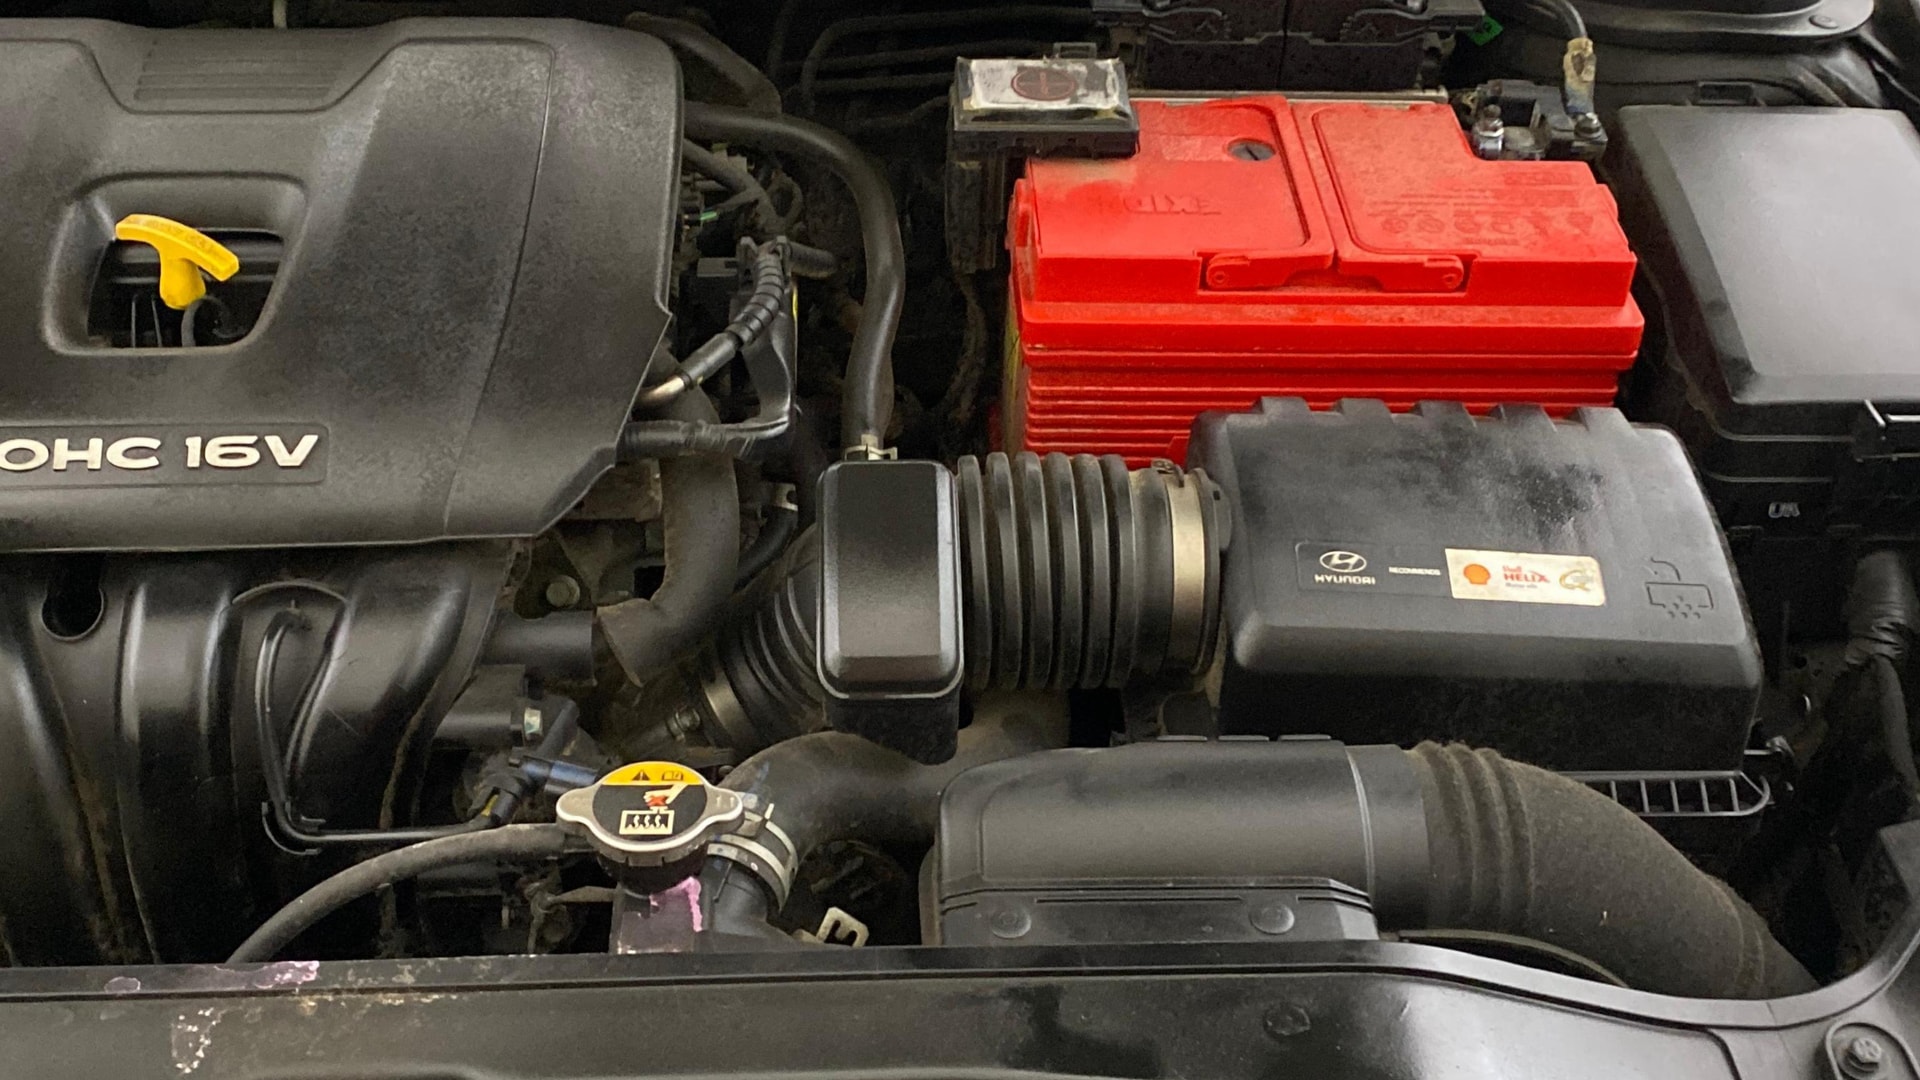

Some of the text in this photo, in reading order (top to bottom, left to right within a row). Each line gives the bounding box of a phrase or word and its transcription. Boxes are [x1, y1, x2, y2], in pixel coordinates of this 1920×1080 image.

[0, 434, 319, 471] OHC 16V
[1314, 574, 1376, 585] HYUNDAI
[1503, 570, 1550, 583] HELIX
